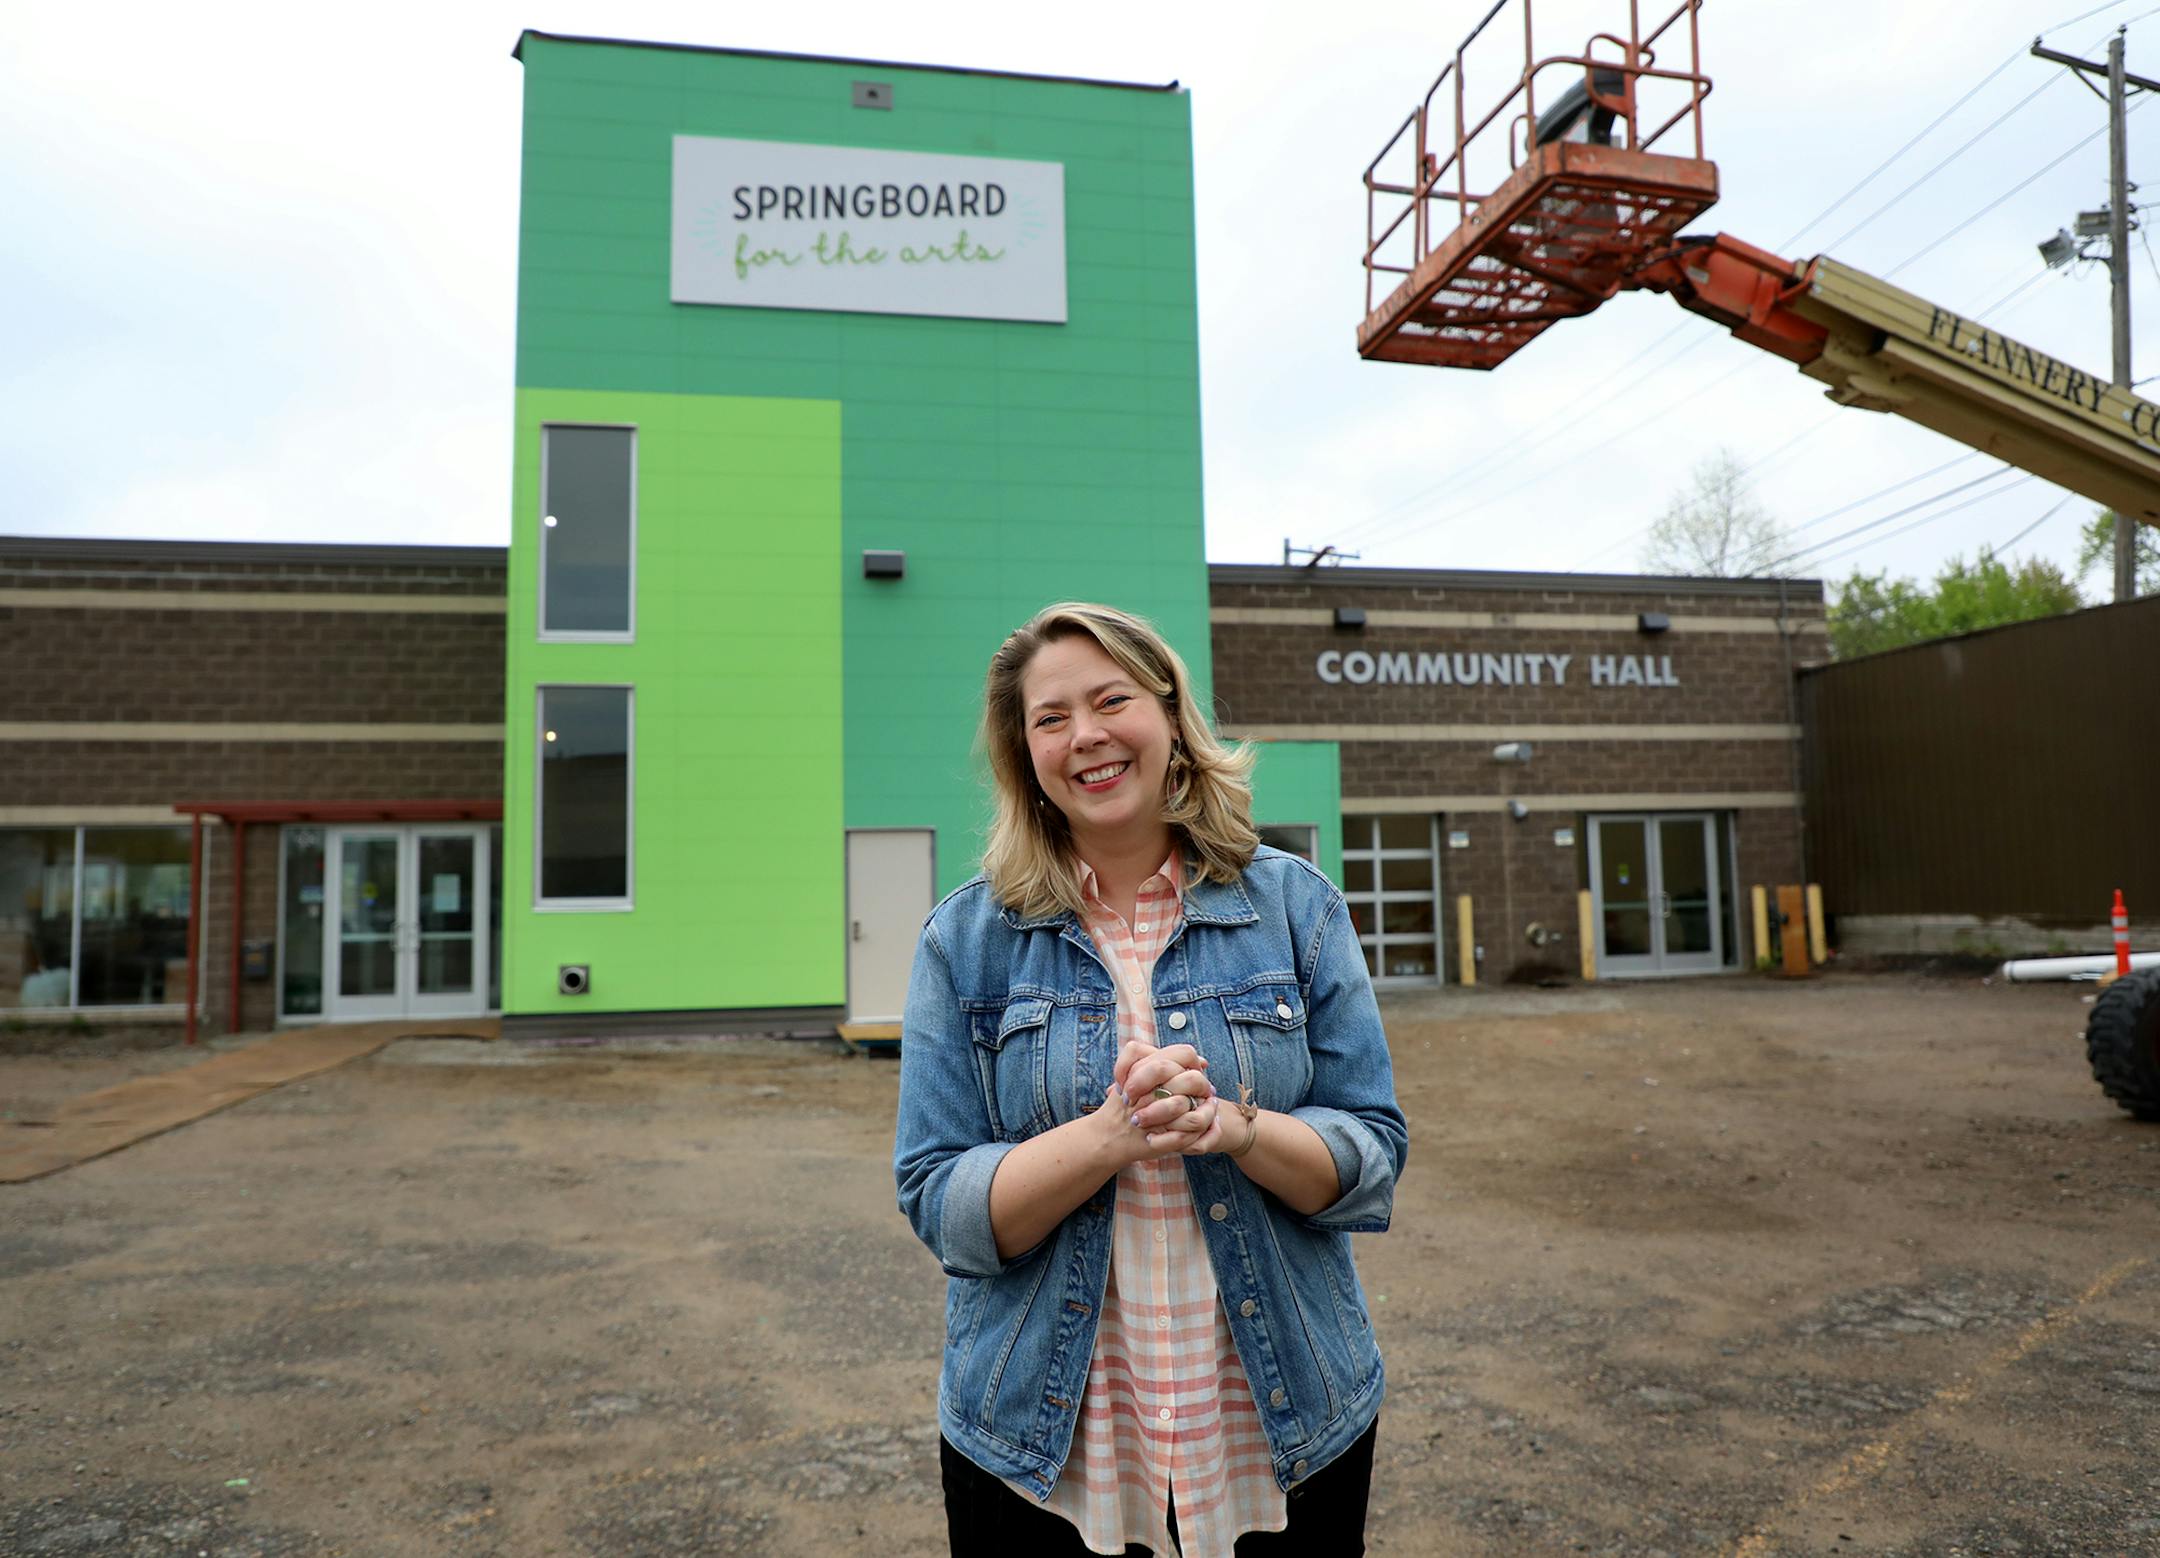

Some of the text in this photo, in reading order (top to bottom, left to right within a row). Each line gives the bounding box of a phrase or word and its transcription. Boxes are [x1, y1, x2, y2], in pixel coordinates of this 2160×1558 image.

[733, 184, 1006, 220] SPRINGBOARD
[734, 229, 1005, 280] for the arts
[1928, 307, 2110, 413] FLANNERY
[1316, 650, 1680, 687] COMMUNITY HALL
